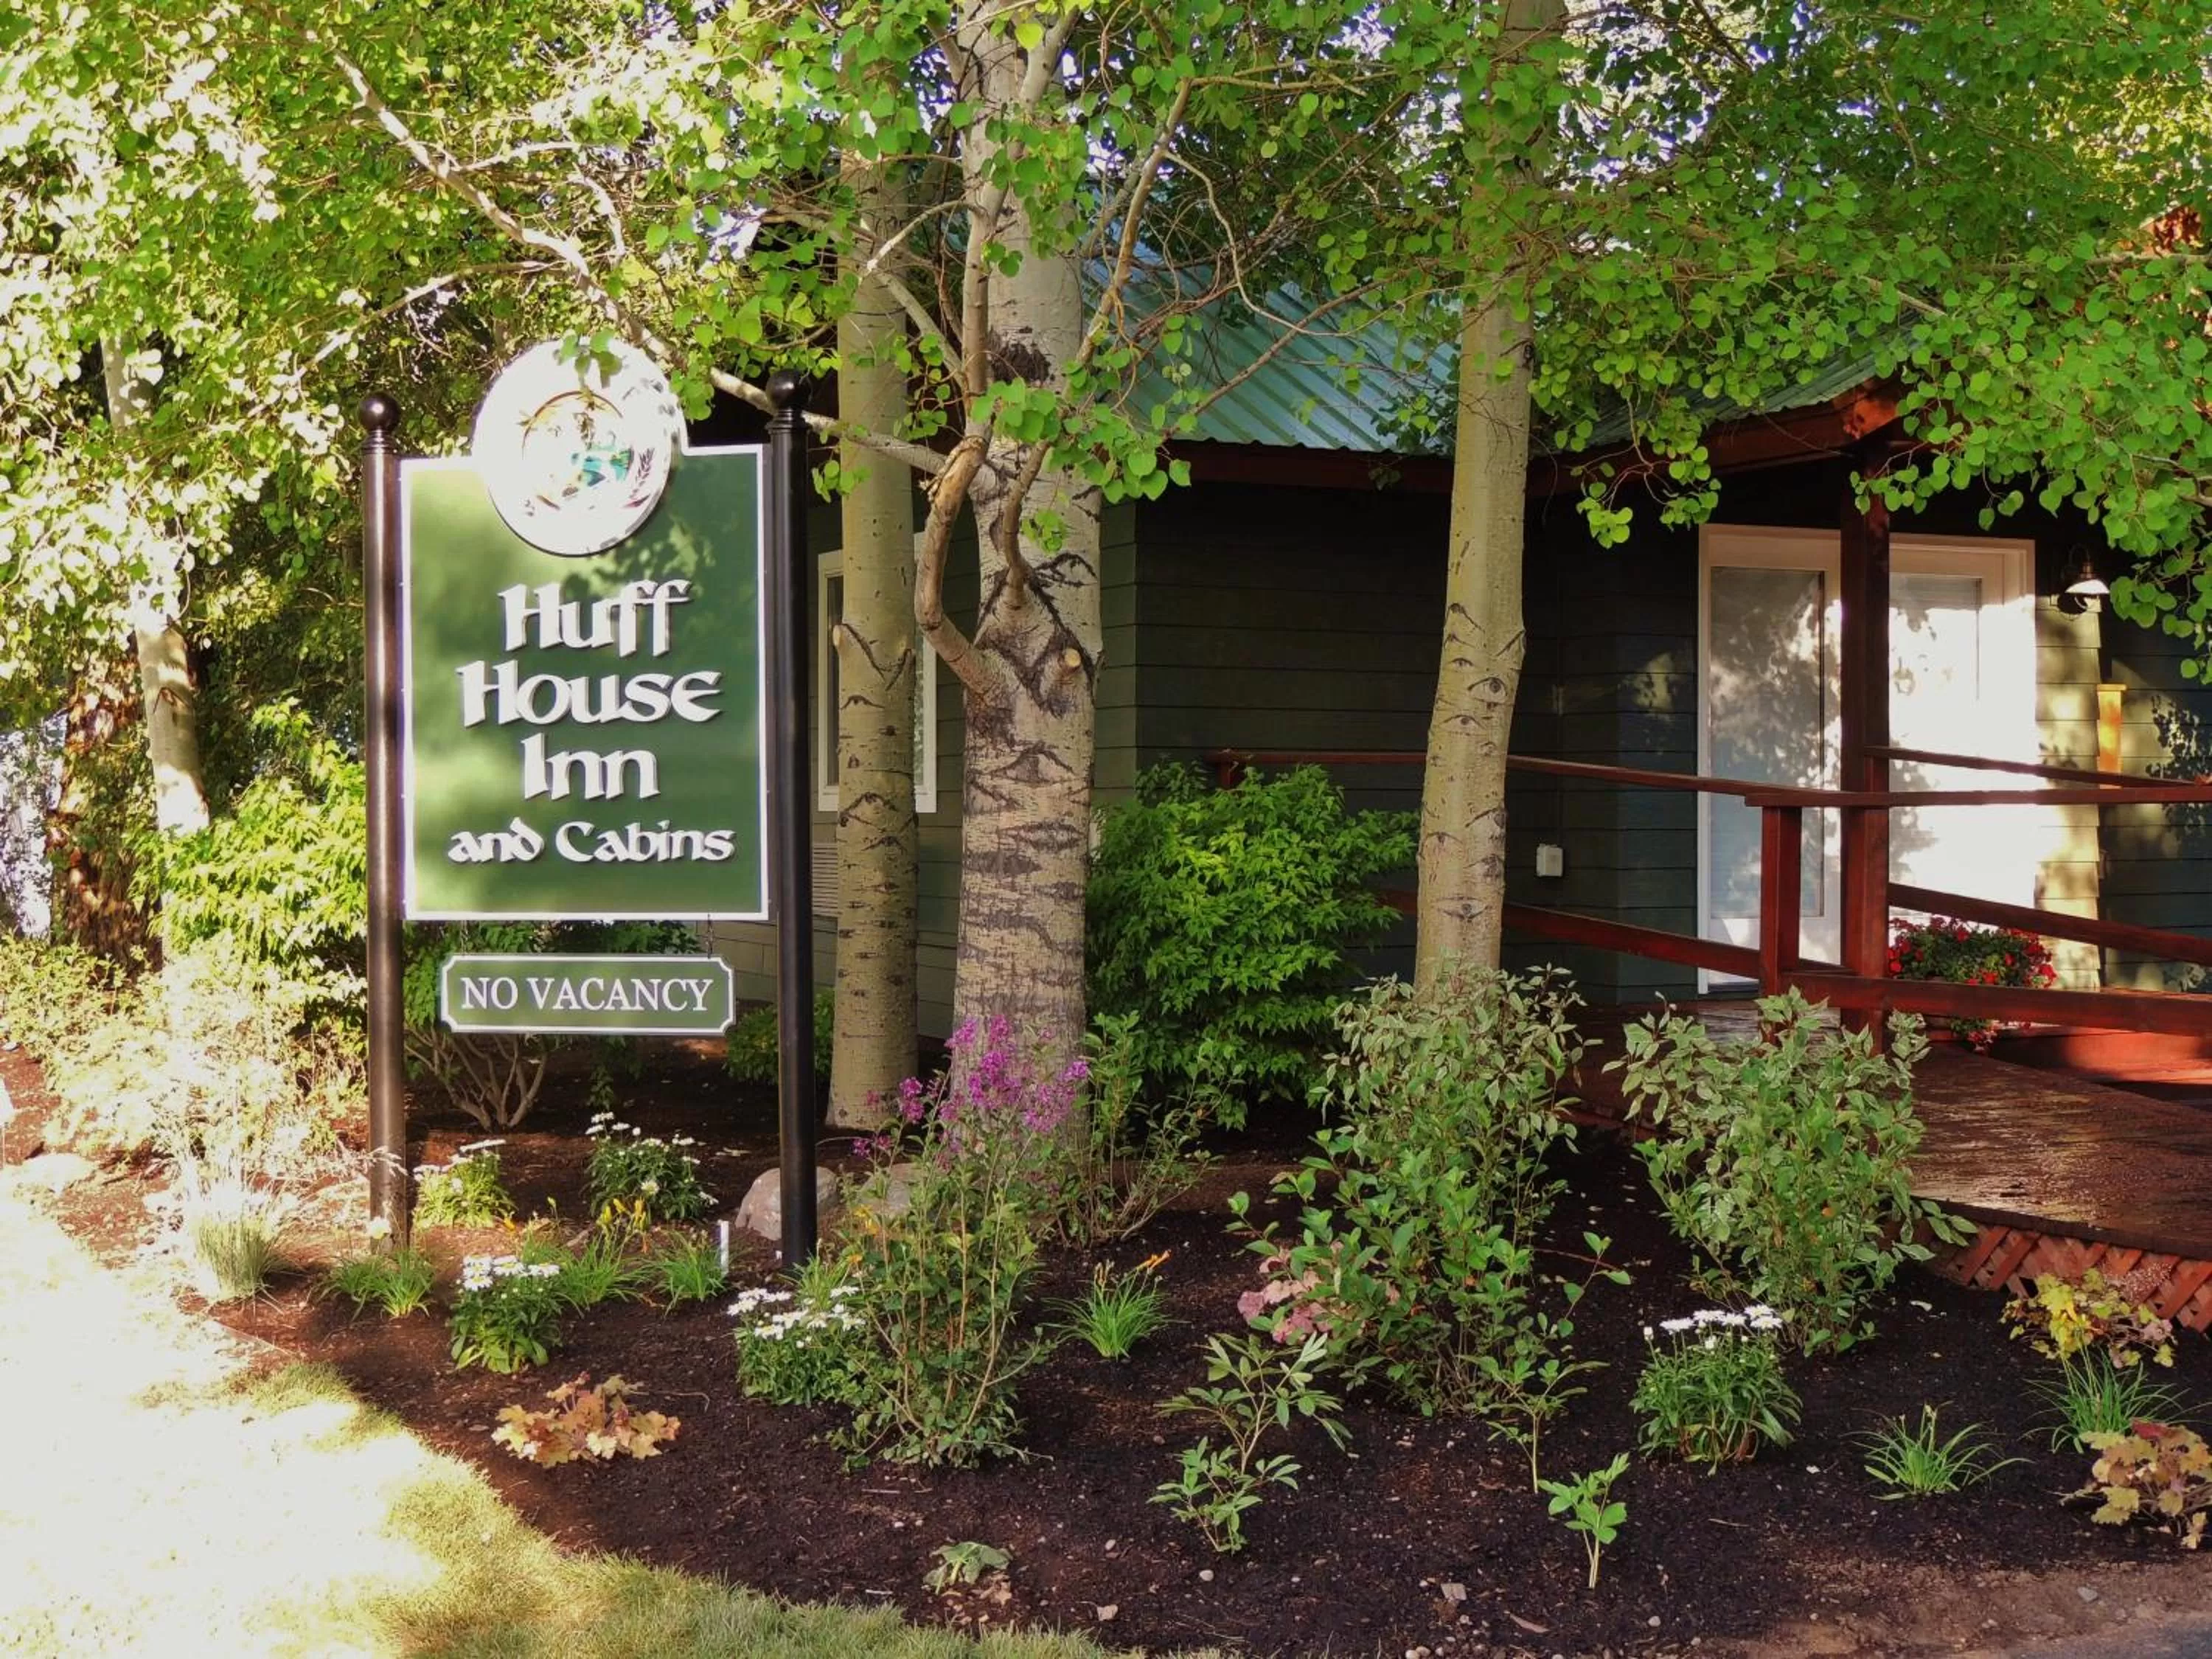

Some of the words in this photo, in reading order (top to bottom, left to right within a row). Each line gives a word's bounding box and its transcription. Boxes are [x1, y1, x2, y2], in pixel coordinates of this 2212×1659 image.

[498, 580, 692, 657] Huff
[457, 660, 723, 727] House
[521, 733, 661, 800] Inn
[448, 817, 543, 862] and
[556, 820, 736, 862] Cabins
[462, 978, 518, 1009] NO
[527, 978, 713, 1009] VACANCY
